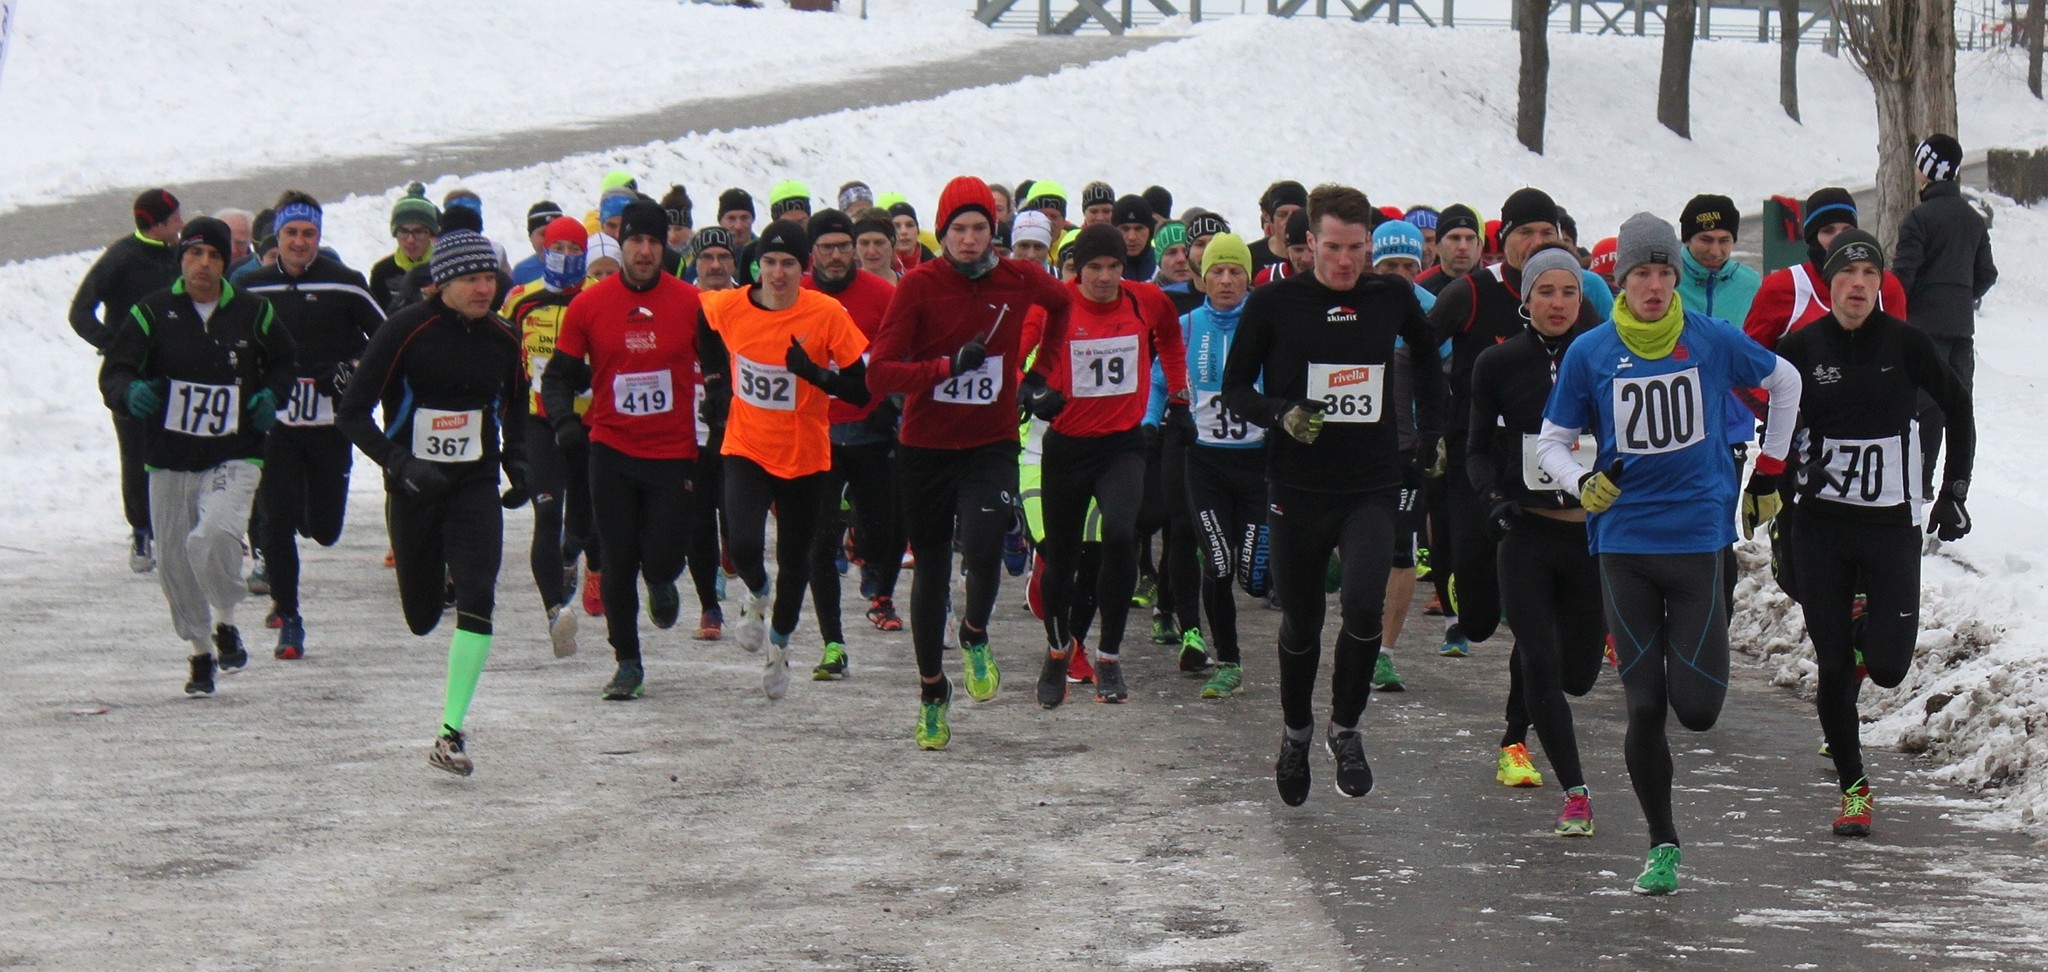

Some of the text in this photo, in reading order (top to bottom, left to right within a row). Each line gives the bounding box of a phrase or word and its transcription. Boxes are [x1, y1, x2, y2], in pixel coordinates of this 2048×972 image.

[1916, 144, 1951, 180] fit
[1089, 357, 1124, 387] 19
[1198, 331, 1210, 382] hellblau.
[741, 368, 789, 401] 392
[943, 377, 993, 400] 418
[1334, 370, 1365, 384] rivella
[179, 385, 231, 434] 179
[622, 390, 666, 413] 419
[1322, 394, 1373, 416] 363
[1621, 375, 1694, 449] 200
[436, 417, 464, 427] rivella
[426, 436, 470, 456] 367
[1838, 444, 1884, 502] 70
[1200, 510, 1227, 578] hellblau.com
